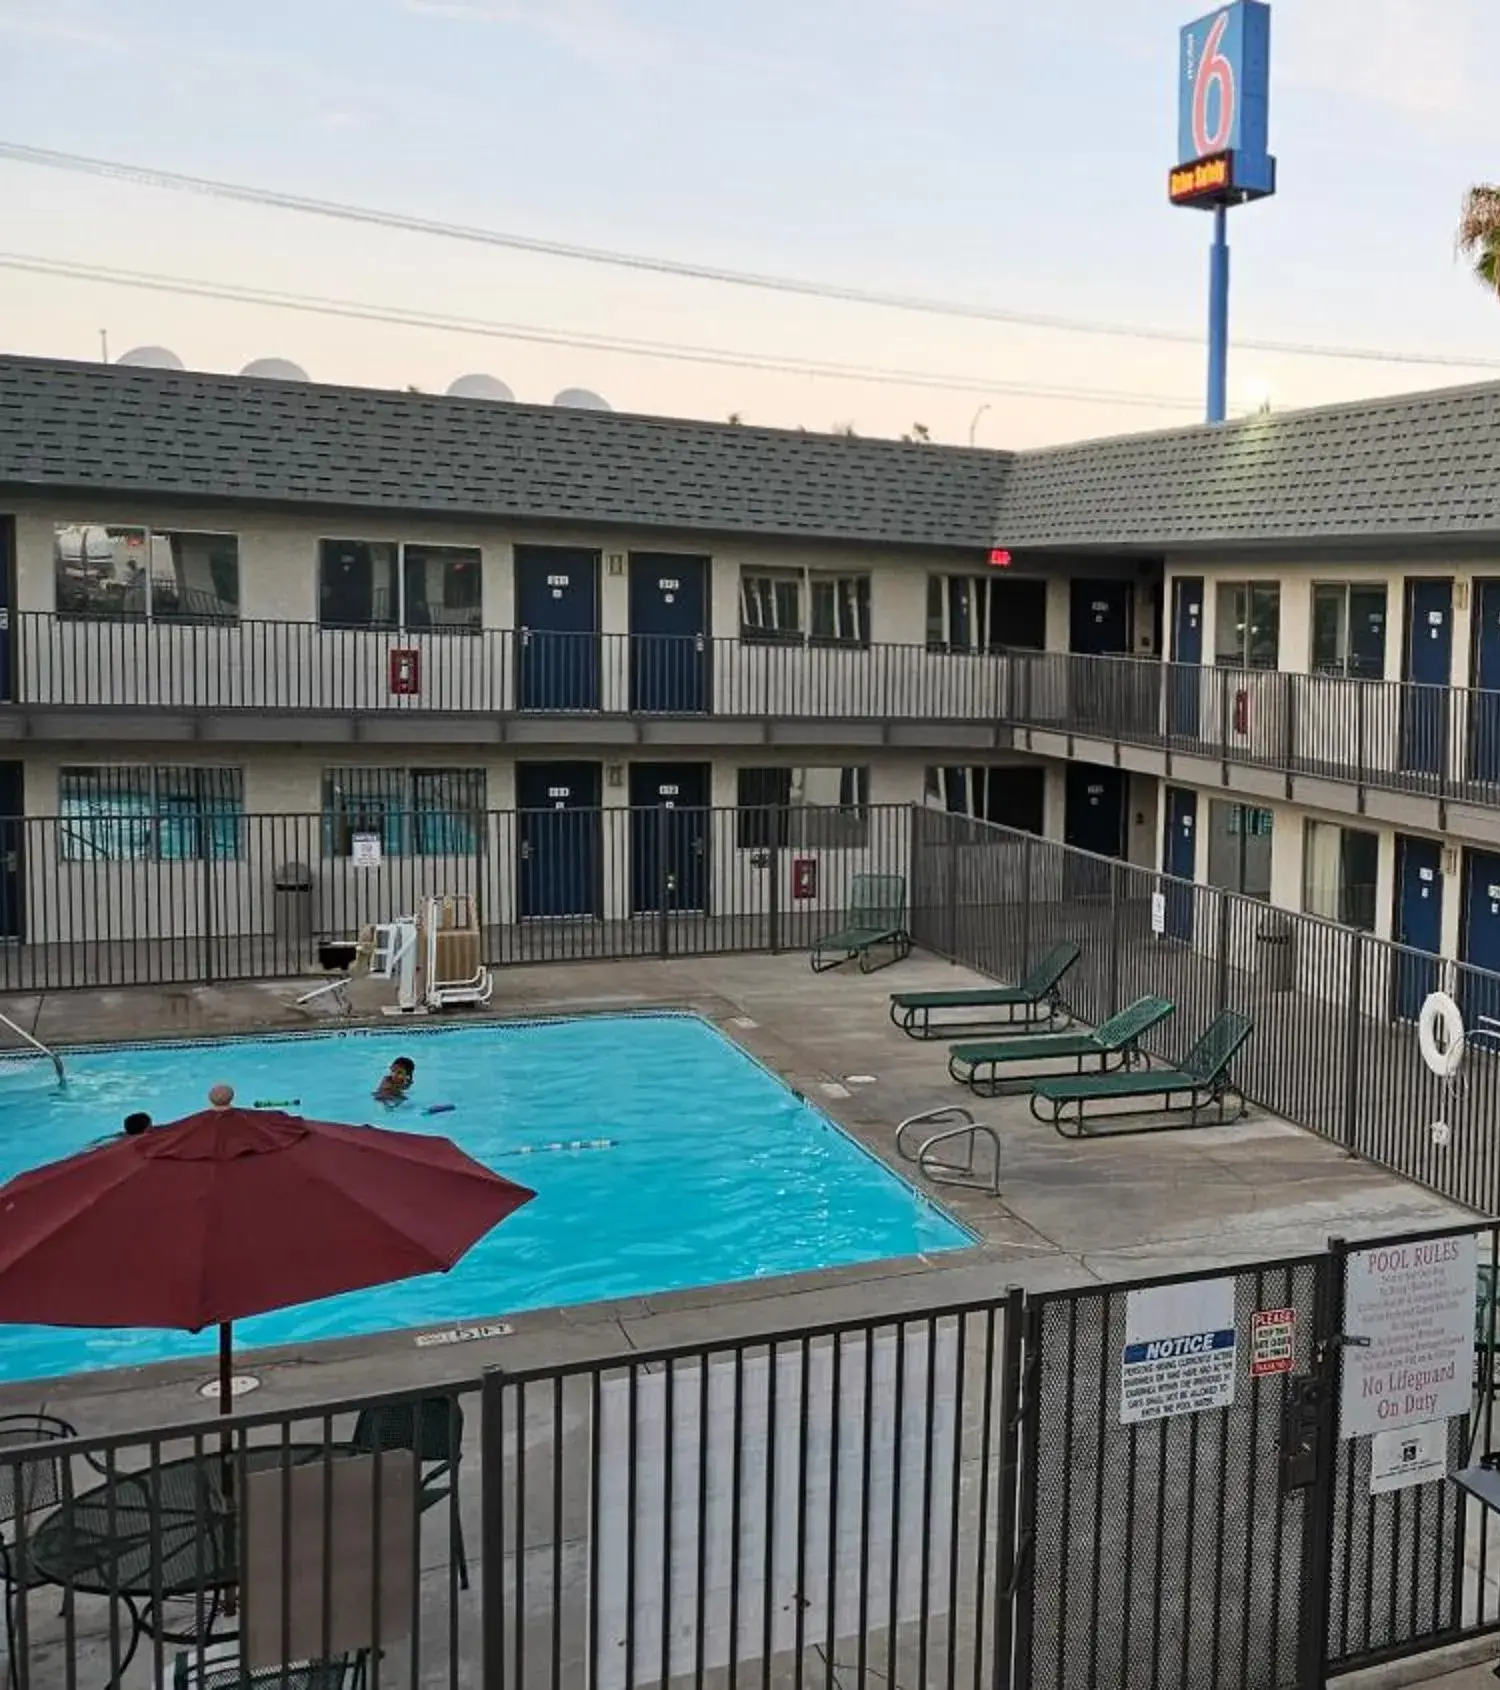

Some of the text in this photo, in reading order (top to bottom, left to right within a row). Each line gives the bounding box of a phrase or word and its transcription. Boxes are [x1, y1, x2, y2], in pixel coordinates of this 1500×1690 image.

[1191, 10, 1235, 157] 6
[1367, 1250, 1408, 1274] POOL
[1415, 1240, 1459, 1266] RULES
[1146, 1333, 1215, 1359] NOTICE
[1362, 1360, 1455, 1398] No Lifeguard
[1377, 1392, 1438, 1419] On Duty
